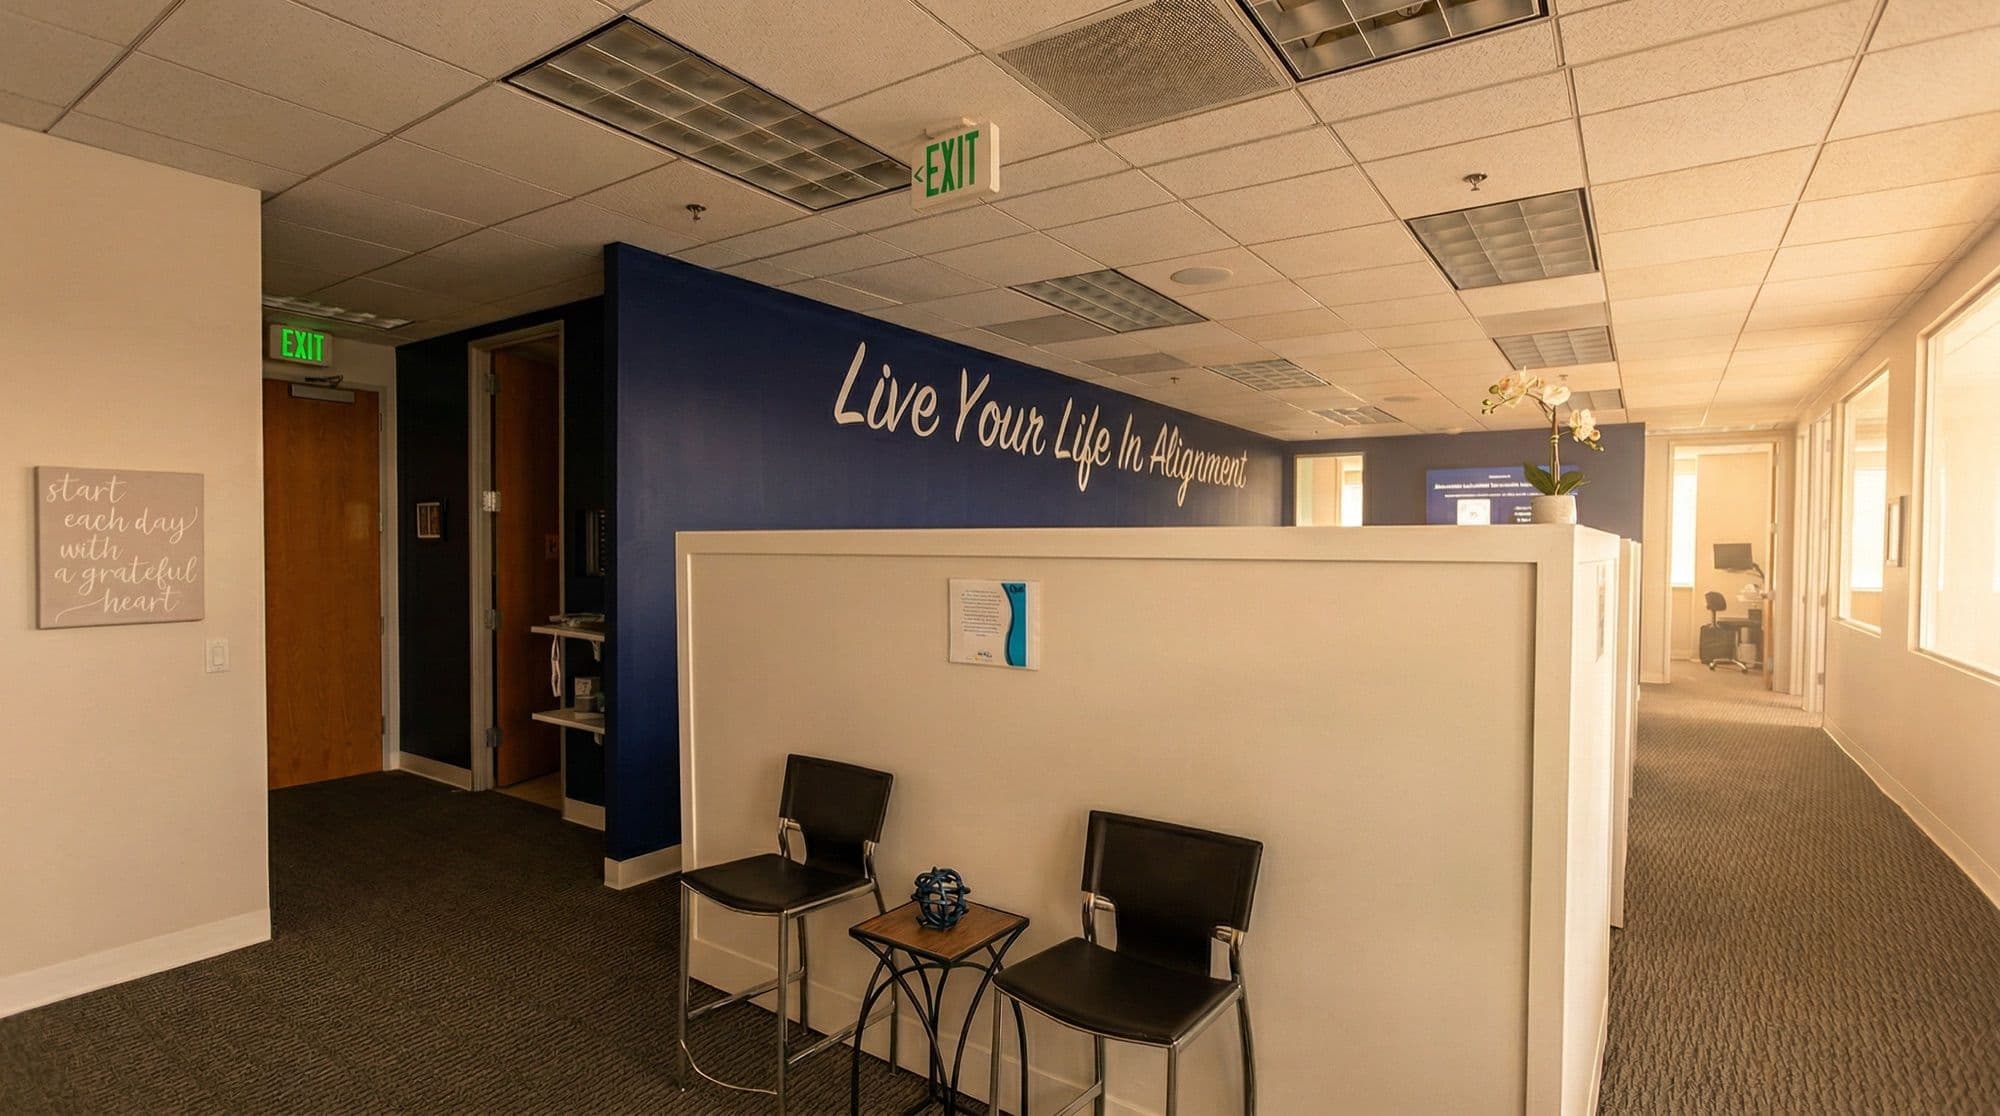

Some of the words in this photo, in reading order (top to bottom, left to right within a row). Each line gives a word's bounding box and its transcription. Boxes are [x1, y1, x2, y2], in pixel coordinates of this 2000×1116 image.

[926, 129, 979, 198] EXIT
[281, 327, 325, 362] EXIT
[834, 341, 940, 437] Live
[954, 367, 1046, 456] Your
[1054, 397, 1111, 492] Life
[1118, 413, 1144, 473] In
[1149, 421, 1249, 508] Alignment
[46, 472, 128, 503] start
[64, 506, 130, 533] each
[135, 507, 199, 545] day
[60, 534, 124, 560] with
[54, 567, 77, 584] a
[78, 556, 198, 597] grateful
